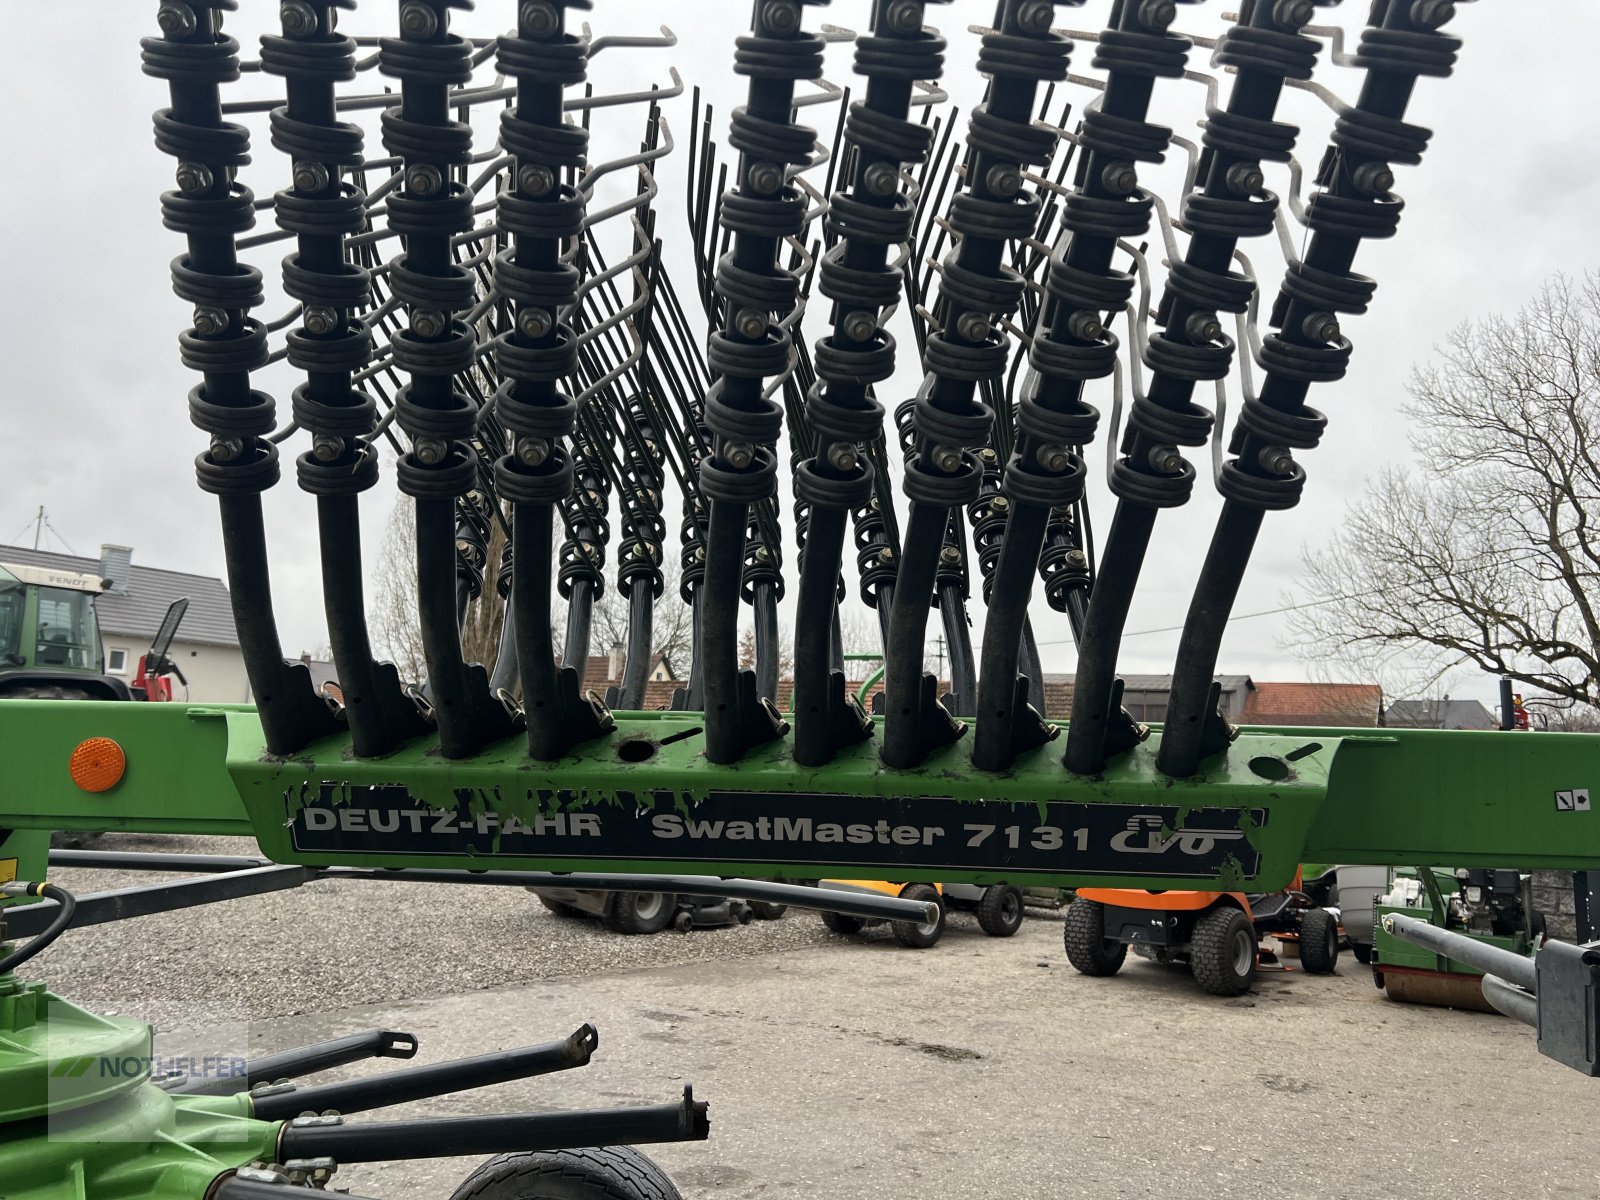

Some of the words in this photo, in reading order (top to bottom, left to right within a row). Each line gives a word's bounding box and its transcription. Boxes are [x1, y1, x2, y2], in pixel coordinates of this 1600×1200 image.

[49, 576, 88, 586] FENDT
[305, 808, 601, 836] DEUTZ-FAHR
[652, 814, 945, 845] SwatMaster
[964, 824, 1089, 851] 7131
